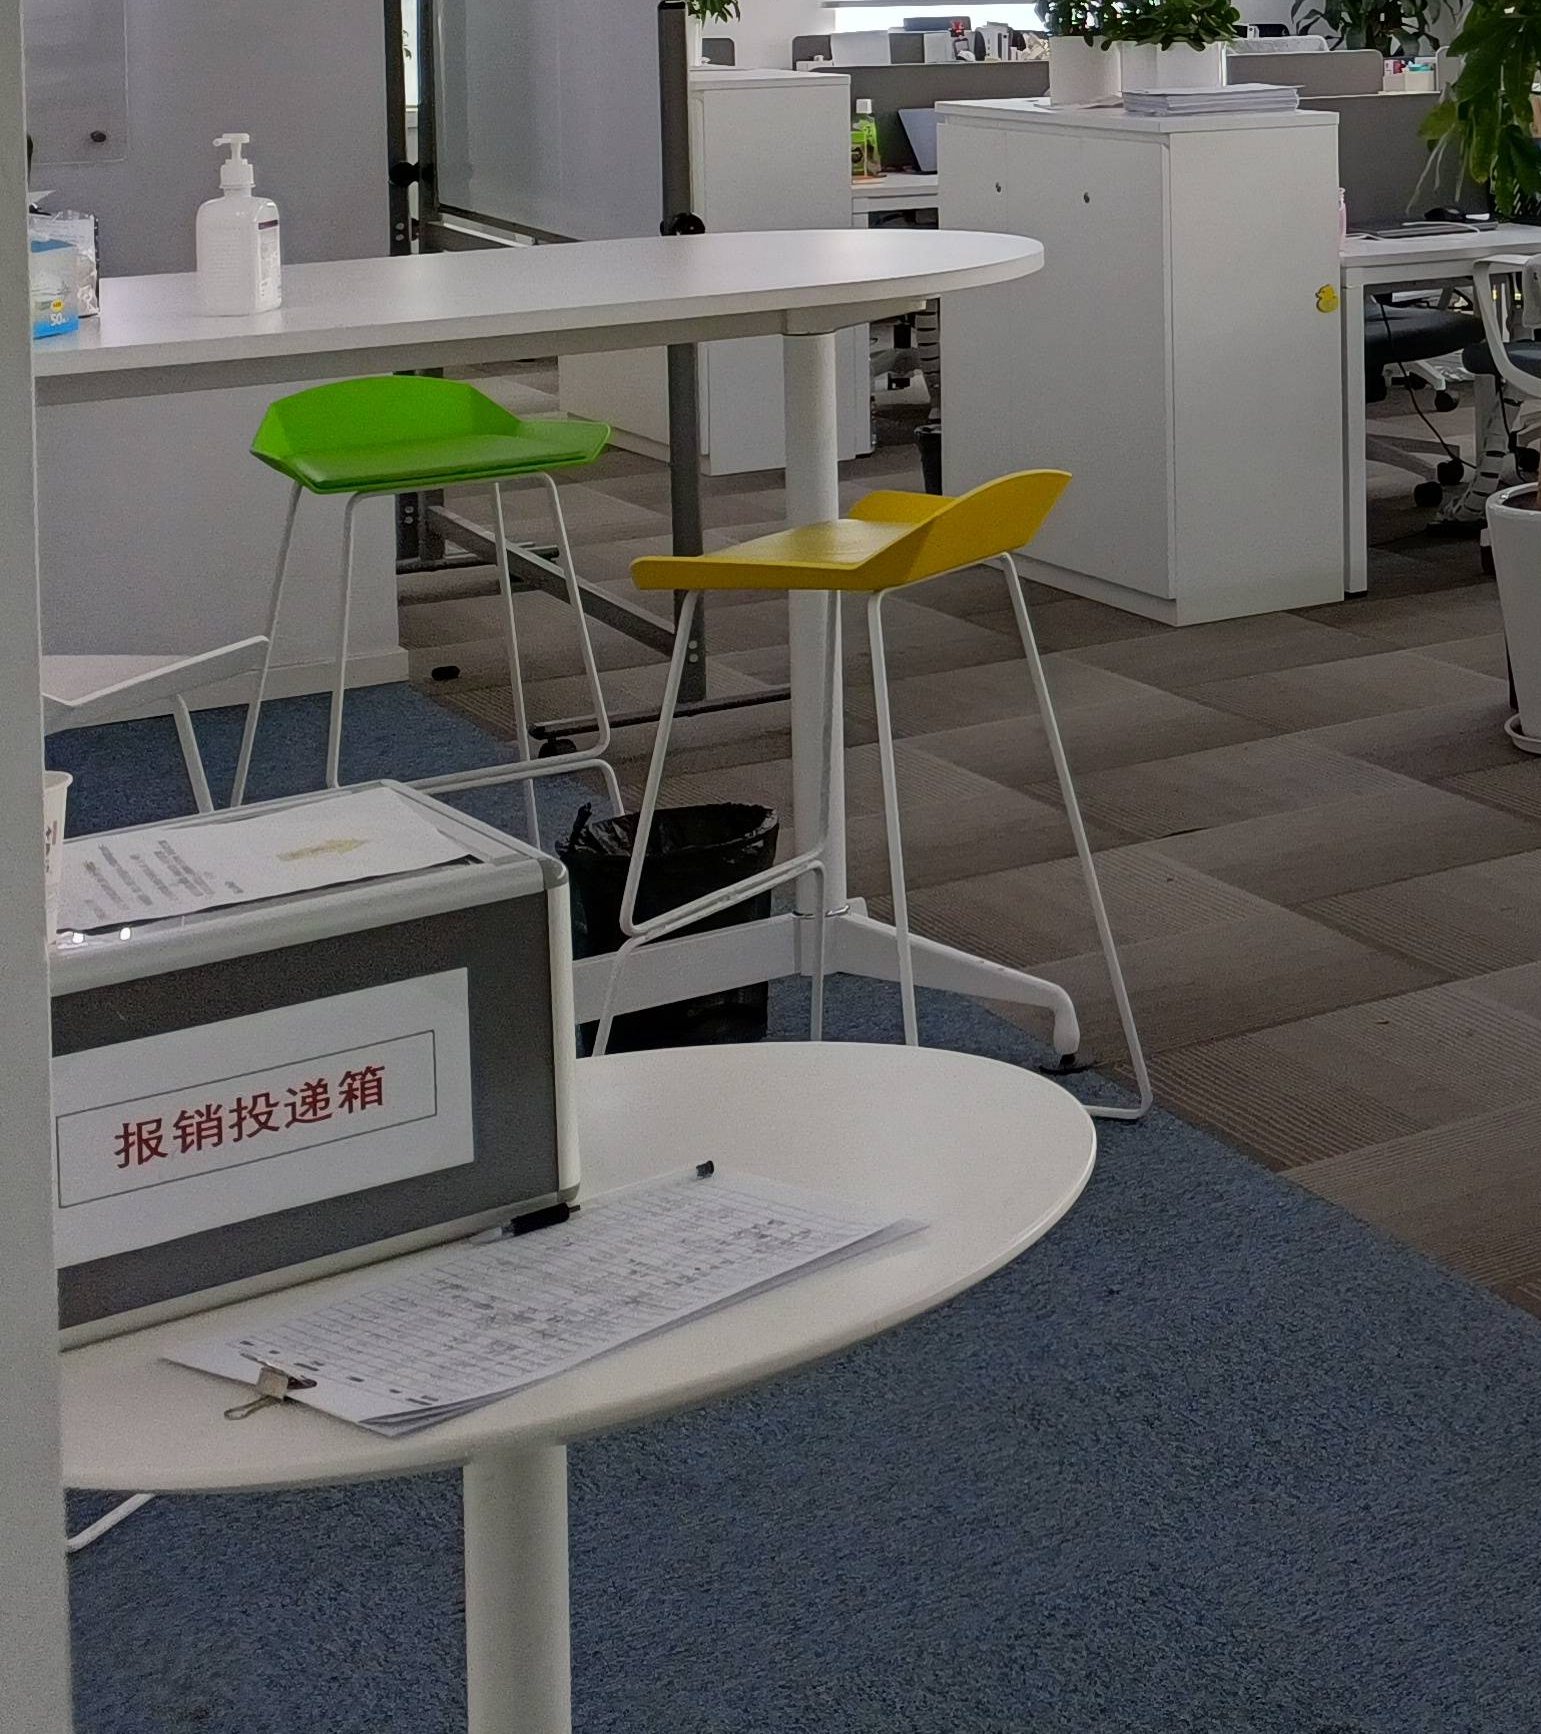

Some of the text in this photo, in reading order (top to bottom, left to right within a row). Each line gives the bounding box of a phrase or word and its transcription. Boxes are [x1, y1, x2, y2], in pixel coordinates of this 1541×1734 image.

[113, 1065, 386, 1169] 报销投递箱
